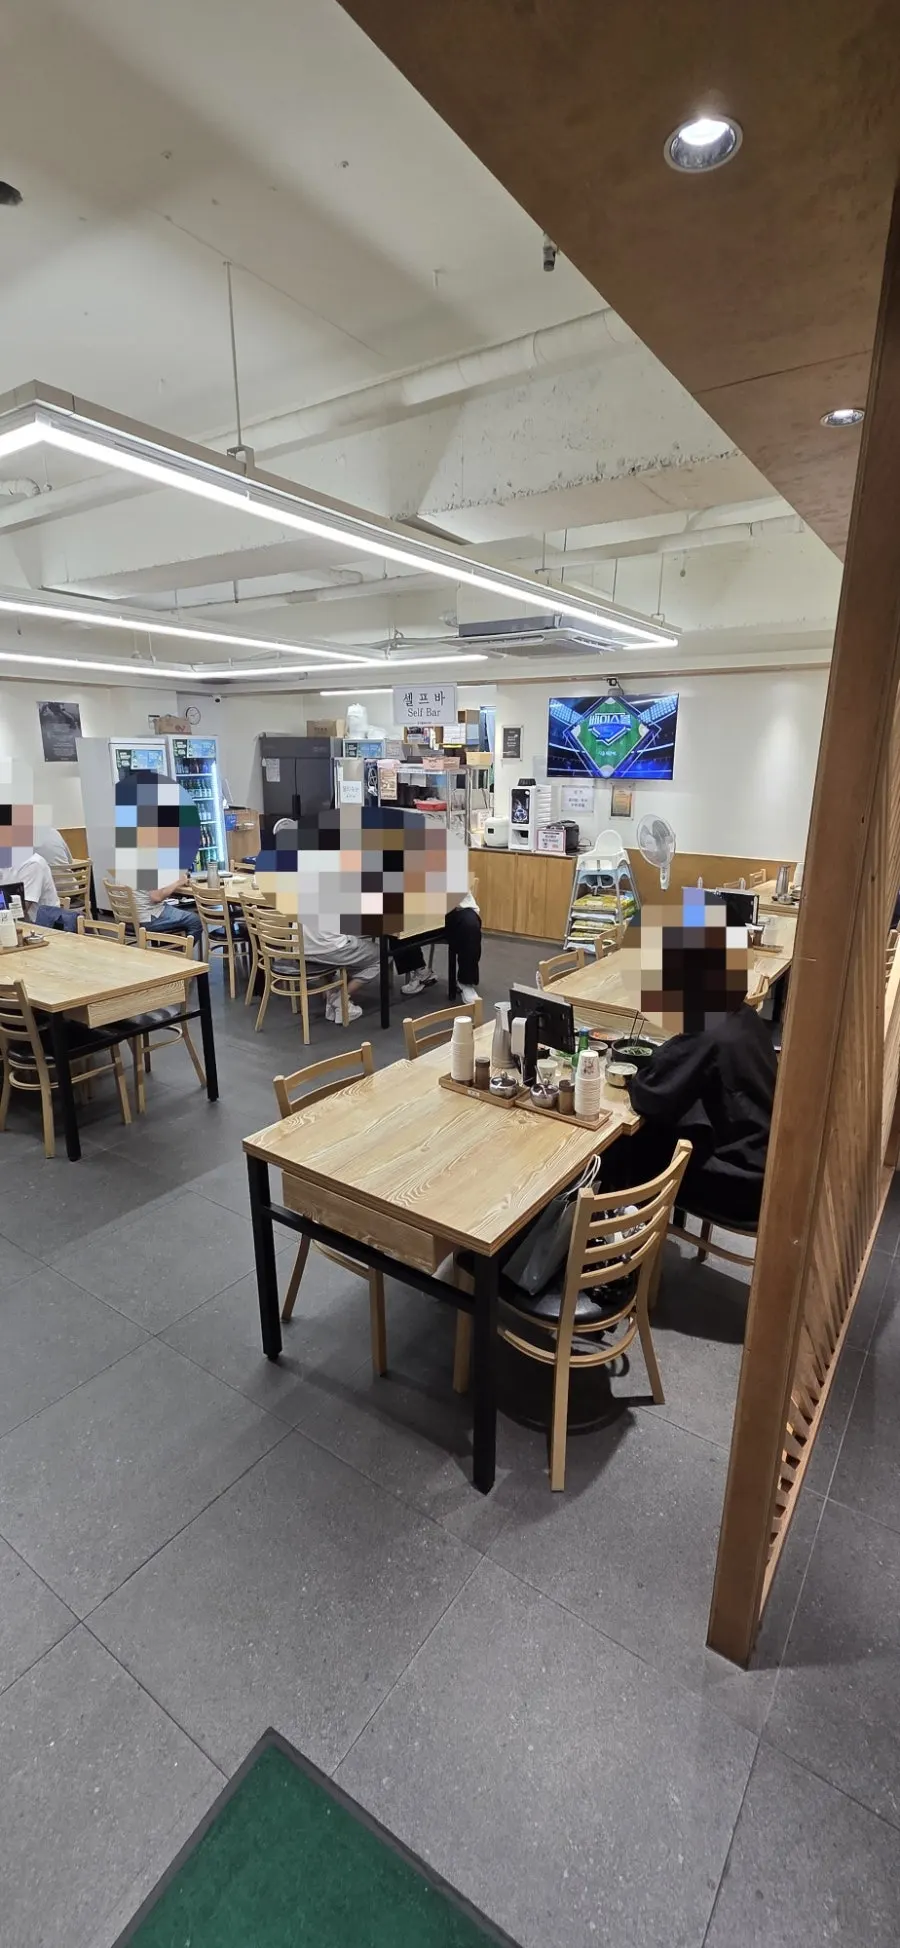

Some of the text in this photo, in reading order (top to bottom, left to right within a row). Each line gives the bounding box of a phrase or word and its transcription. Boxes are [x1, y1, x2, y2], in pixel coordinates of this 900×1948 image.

[407, 707, 441, 717] Self Bar
[588, 714, 631, 725] 베이스볼
